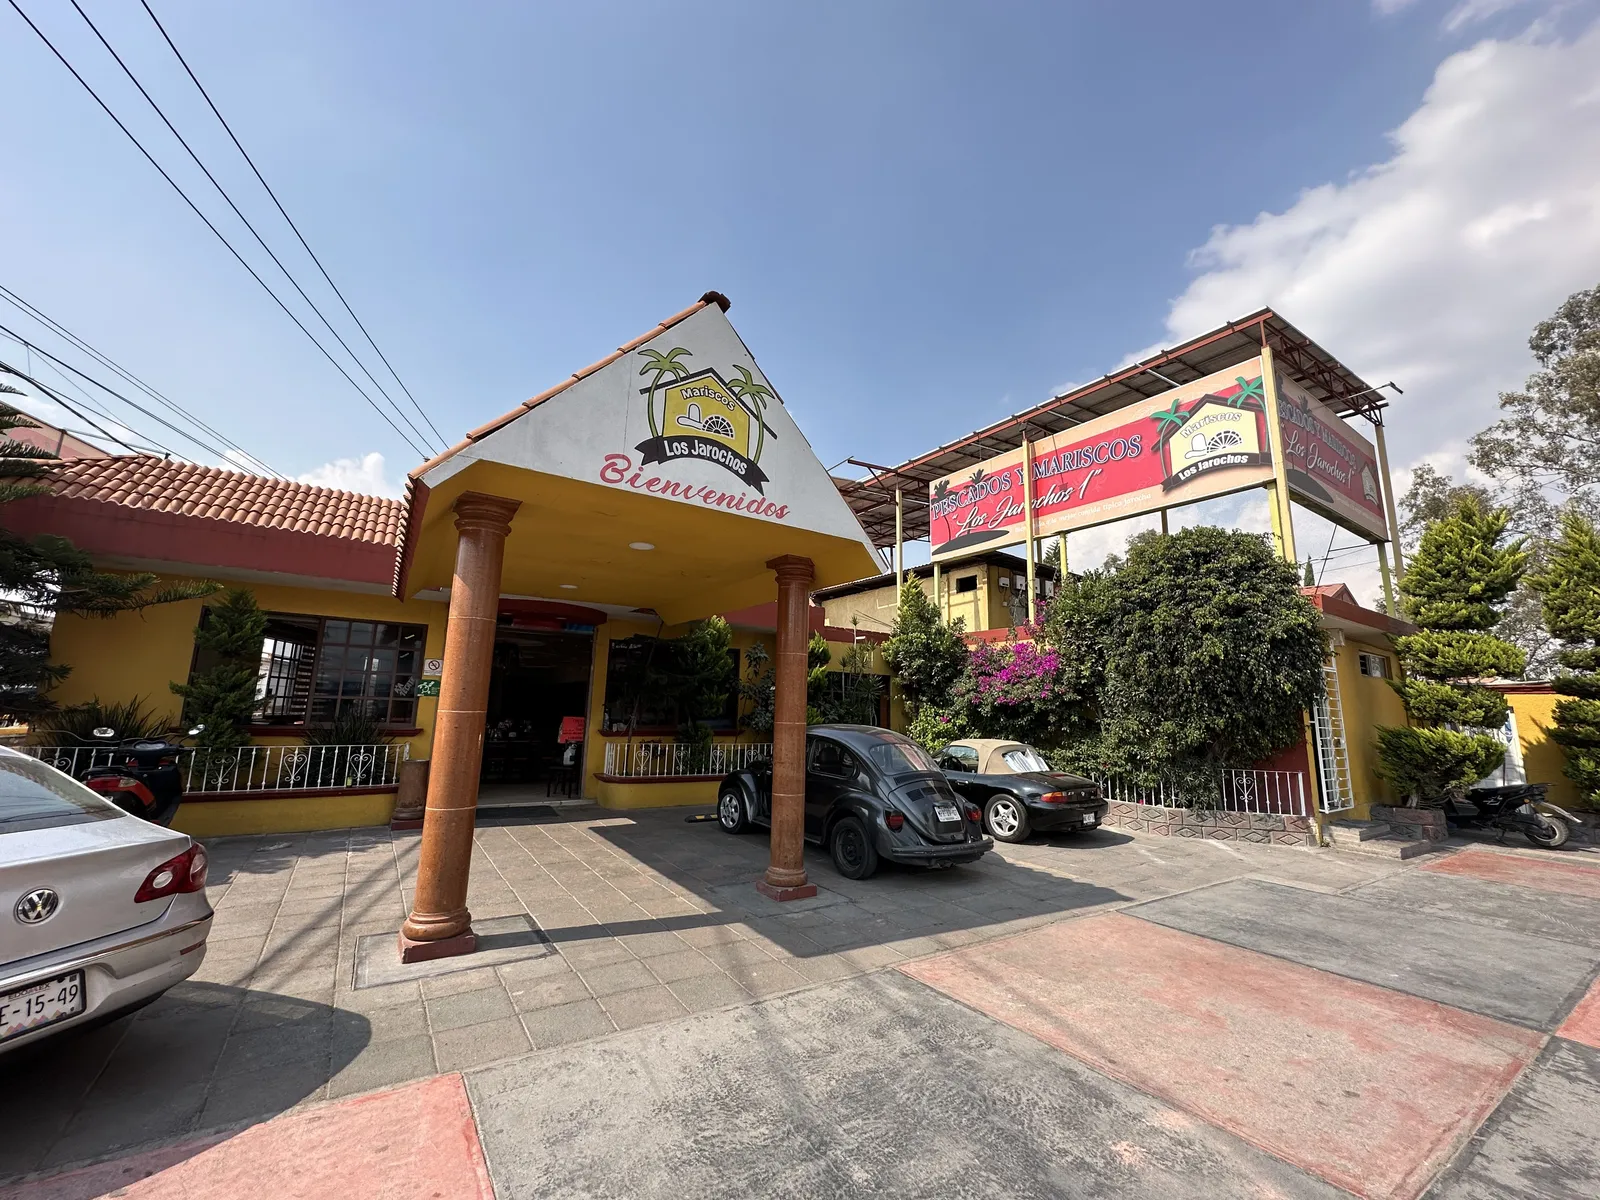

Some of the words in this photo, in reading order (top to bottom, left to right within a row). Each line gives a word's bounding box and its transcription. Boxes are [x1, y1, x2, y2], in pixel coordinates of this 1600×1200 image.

[680, 385, 736, 411] Mariscos
[1180, 412, 1242, 438] Mariscos
[1278, 399, 1315, 434] ESCADOS
[663, 440, 689, 457] Los
[691, 439, 748, 475] Jarochos
[1178, 465, 1197, 480] Los
[1198, 454, 1249, 471] Jarochos
[1307, 443, 1346, 483] Jarochos
[599, 453, 790, 519] Bienvenidos
[931, 471, 1012, 520] PESCADOS
[1032, 434, 1141, 481] MARISCOS
